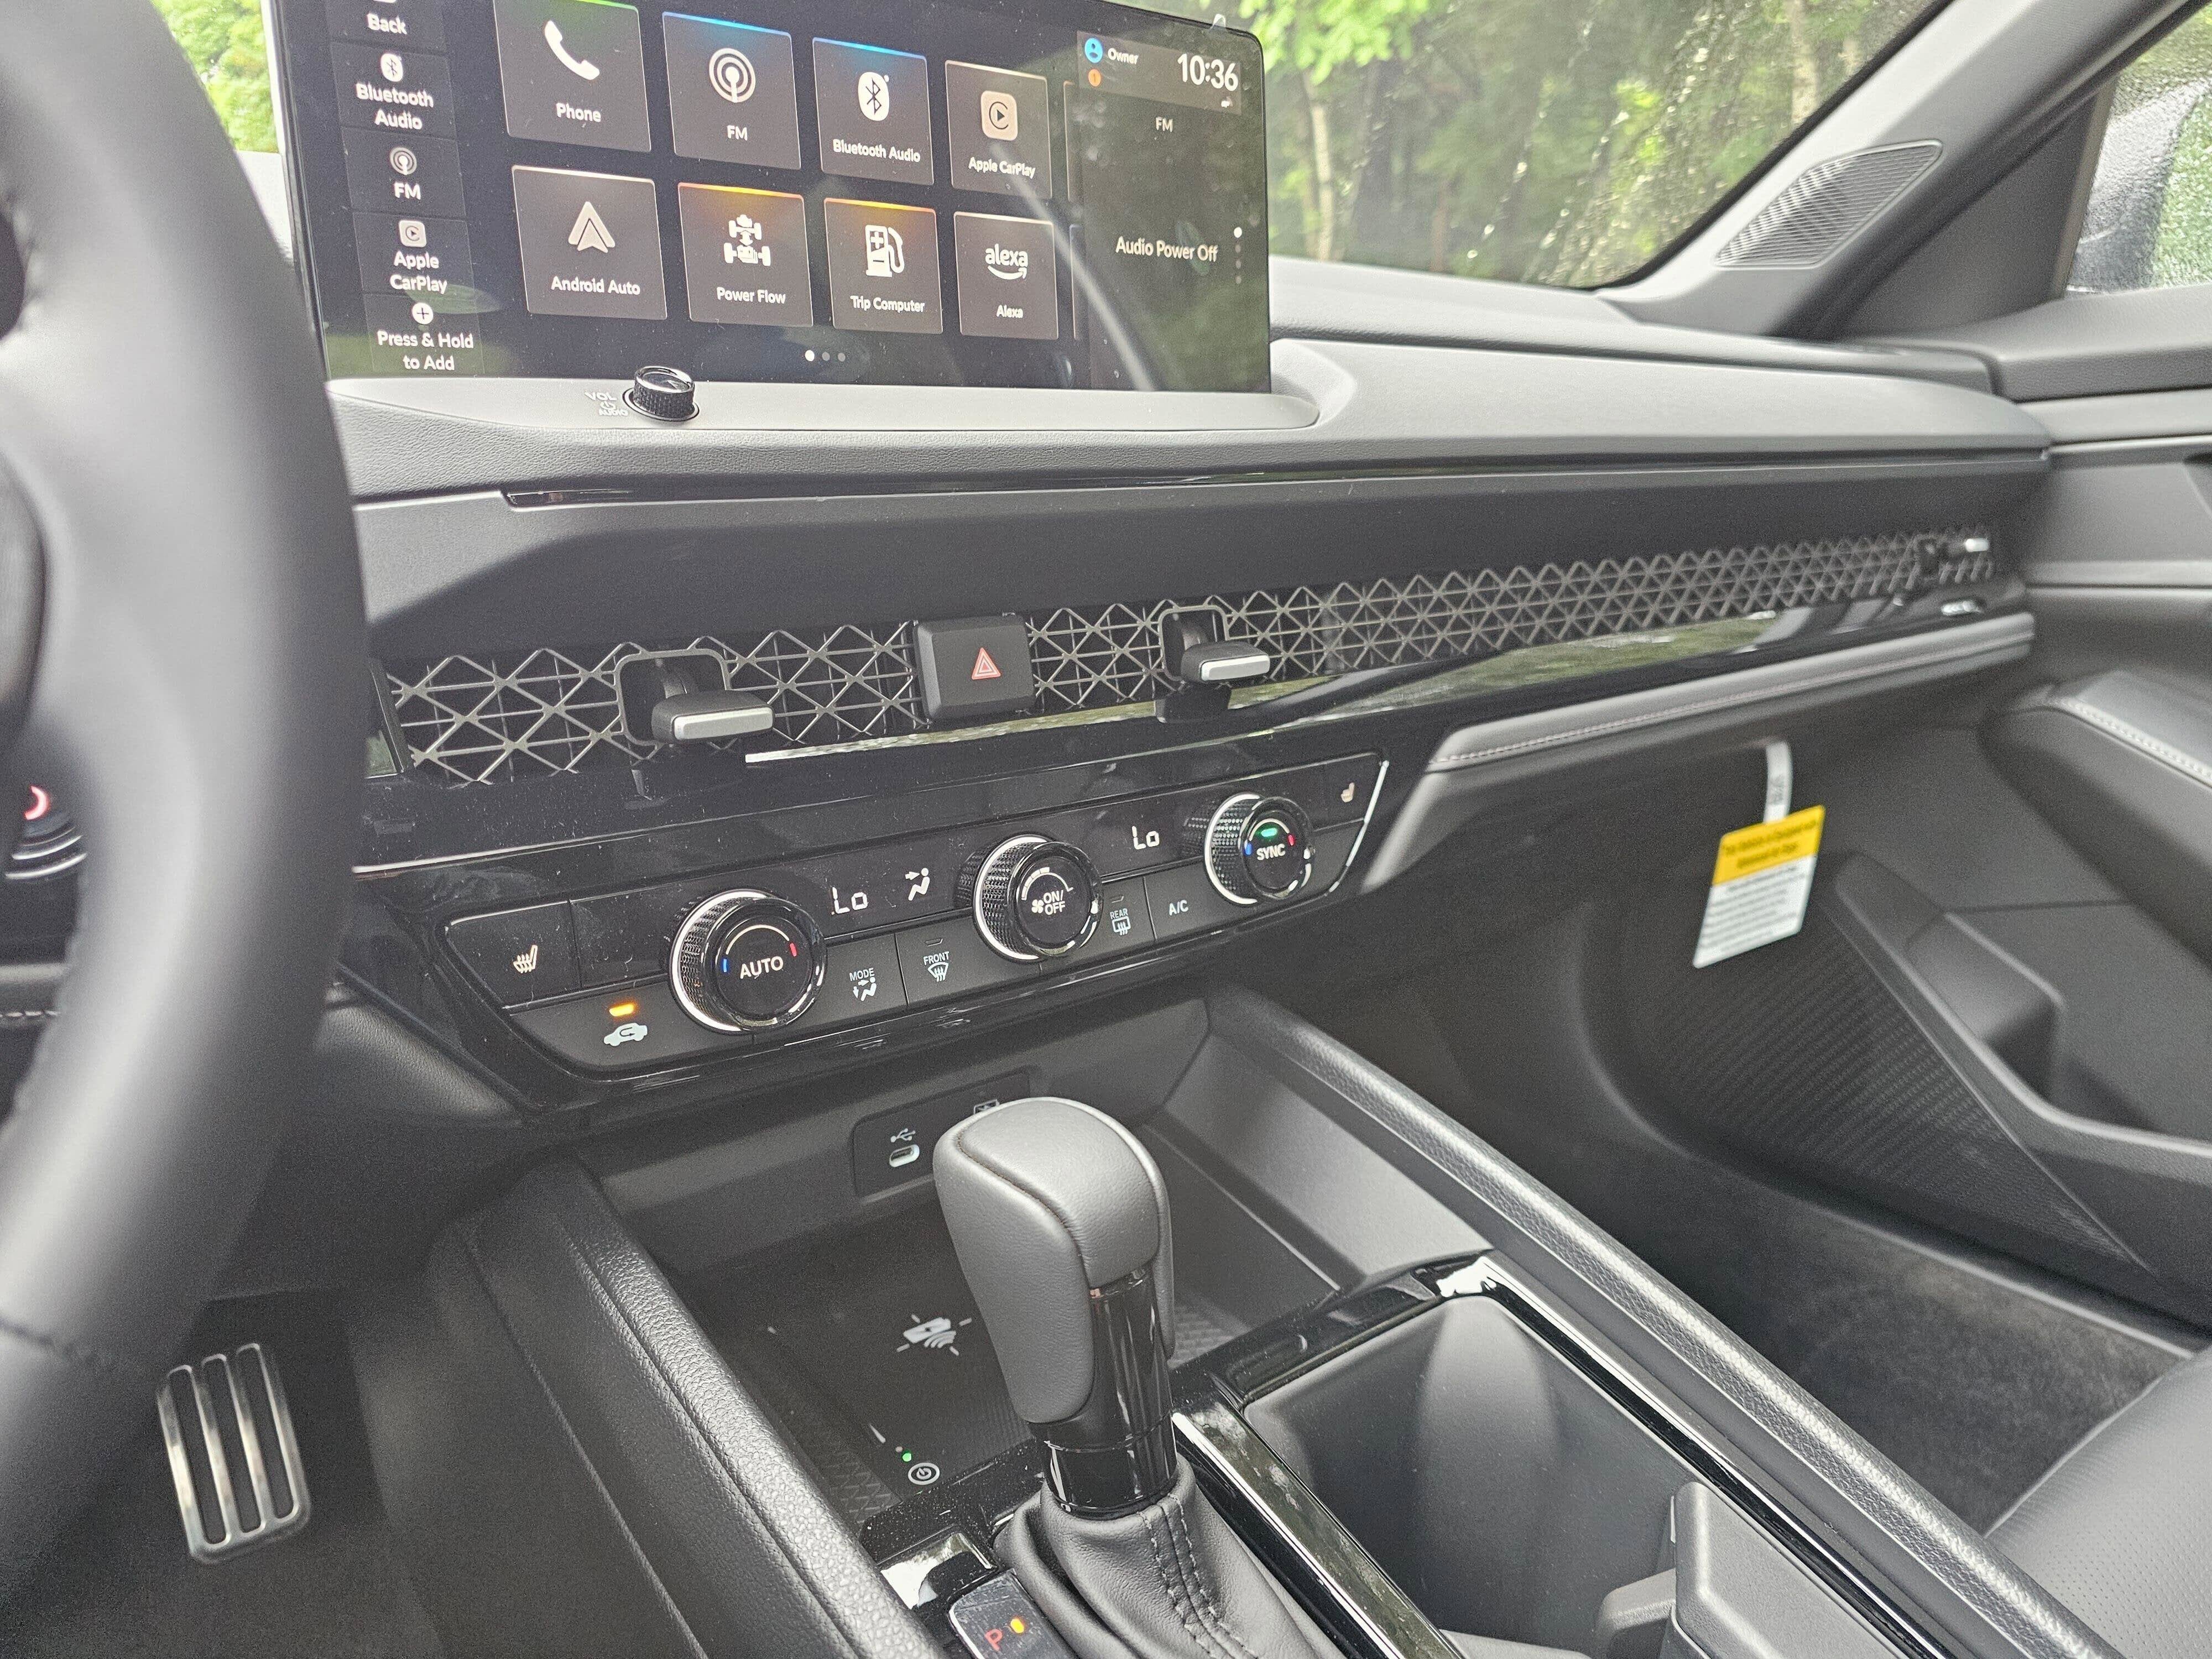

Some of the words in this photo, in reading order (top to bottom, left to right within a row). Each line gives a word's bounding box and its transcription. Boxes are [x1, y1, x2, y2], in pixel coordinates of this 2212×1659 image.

[367, 13, 408, 35] Back
[1108, 48, 1139, 65] Owner
[1177, 54, 1239, 91] 10:36
[356, 83, 434, 108] Bluetooth
[375, 110, 422, 131] Audio
[556, 103, 602, 123] Phone
[727, 125, 748, 141] FM
[1156, 117, 1173, 133] FM
[833, 139, 886, 159] Bluetooth
[889, 145, 921, 163] Audio
[968, 156, 998, 173] Apple
[999, 161, 1036, 179] CarPlay
[394, 182, 421, 200] FM
[985, 244, 1029, 267] alexa
[1115, 237, 1154, 256] Audio
[1156, 240, 1194, 260] Power
[1197, 244, 1218, 262] Off
[394, 251, 439, 270] Apple
[390, 275, 447, 295] CarPlay
[551, 276, 604, 294] Android
[608, 279, 640, 296] Auto
[717, 287, 754, 305] Power
[758, 290, 786, 305] Flow
[851, 295, 871, 311] Trip
[873, 296, 925, 313] Computer
[997, 305, 1023, 319] Alexa
[378, 331, 419, 348] Press
[421, 333, 434, 348] &
[439, 332, 473, 349] Hold
[403, 355, 420, 371] to
[424, 355, 455, 371] Add
[585, 391, 617, 401] VOL
[1131, 826, 1160, 850] Lo
[1256, 846, 1286, 860] SYNC
[832, 887, 868, 914] Lo
[1044, 890, 1063, 905] ON/
[1045, 901, 1066, 915] OFF
[1110, 908, 1128, 919] REAR
[1169, 900, 1189, 915] A/C
[740, 956, 784, 979] AUTO
[923, 951, 950, 966] FRONT
[849, 968, 874, 982] MODE
[984, 1627, 1003, 1652] P
